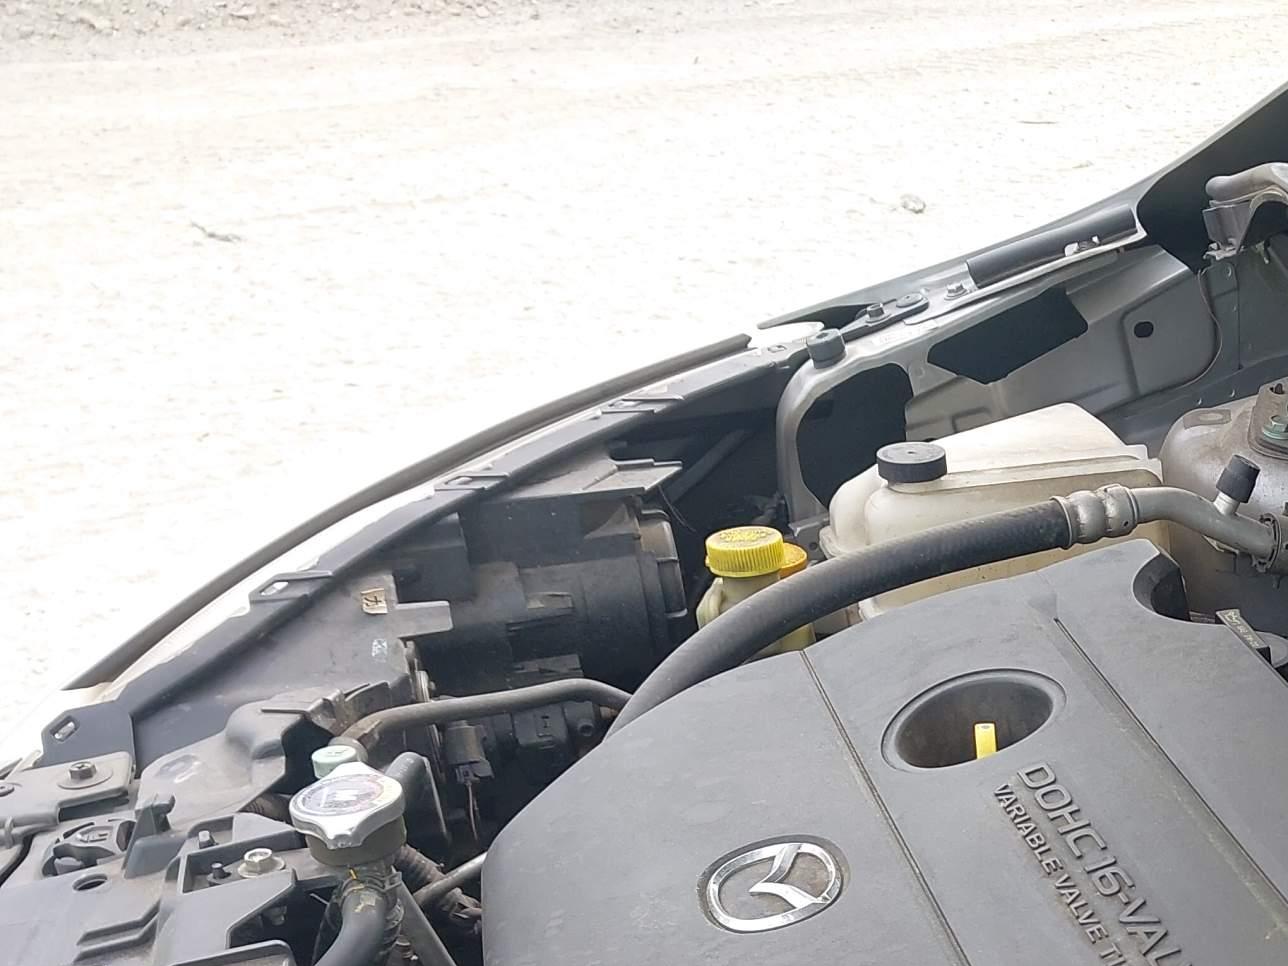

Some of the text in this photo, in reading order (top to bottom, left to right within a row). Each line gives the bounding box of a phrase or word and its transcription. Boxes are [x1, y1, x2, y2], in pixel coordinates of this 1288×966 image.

[993, 783, 1064, 876] VARIABLE
[1054, 874, 1110, 944] VALVE
[1016, 761, 1108, 859] DOHC
